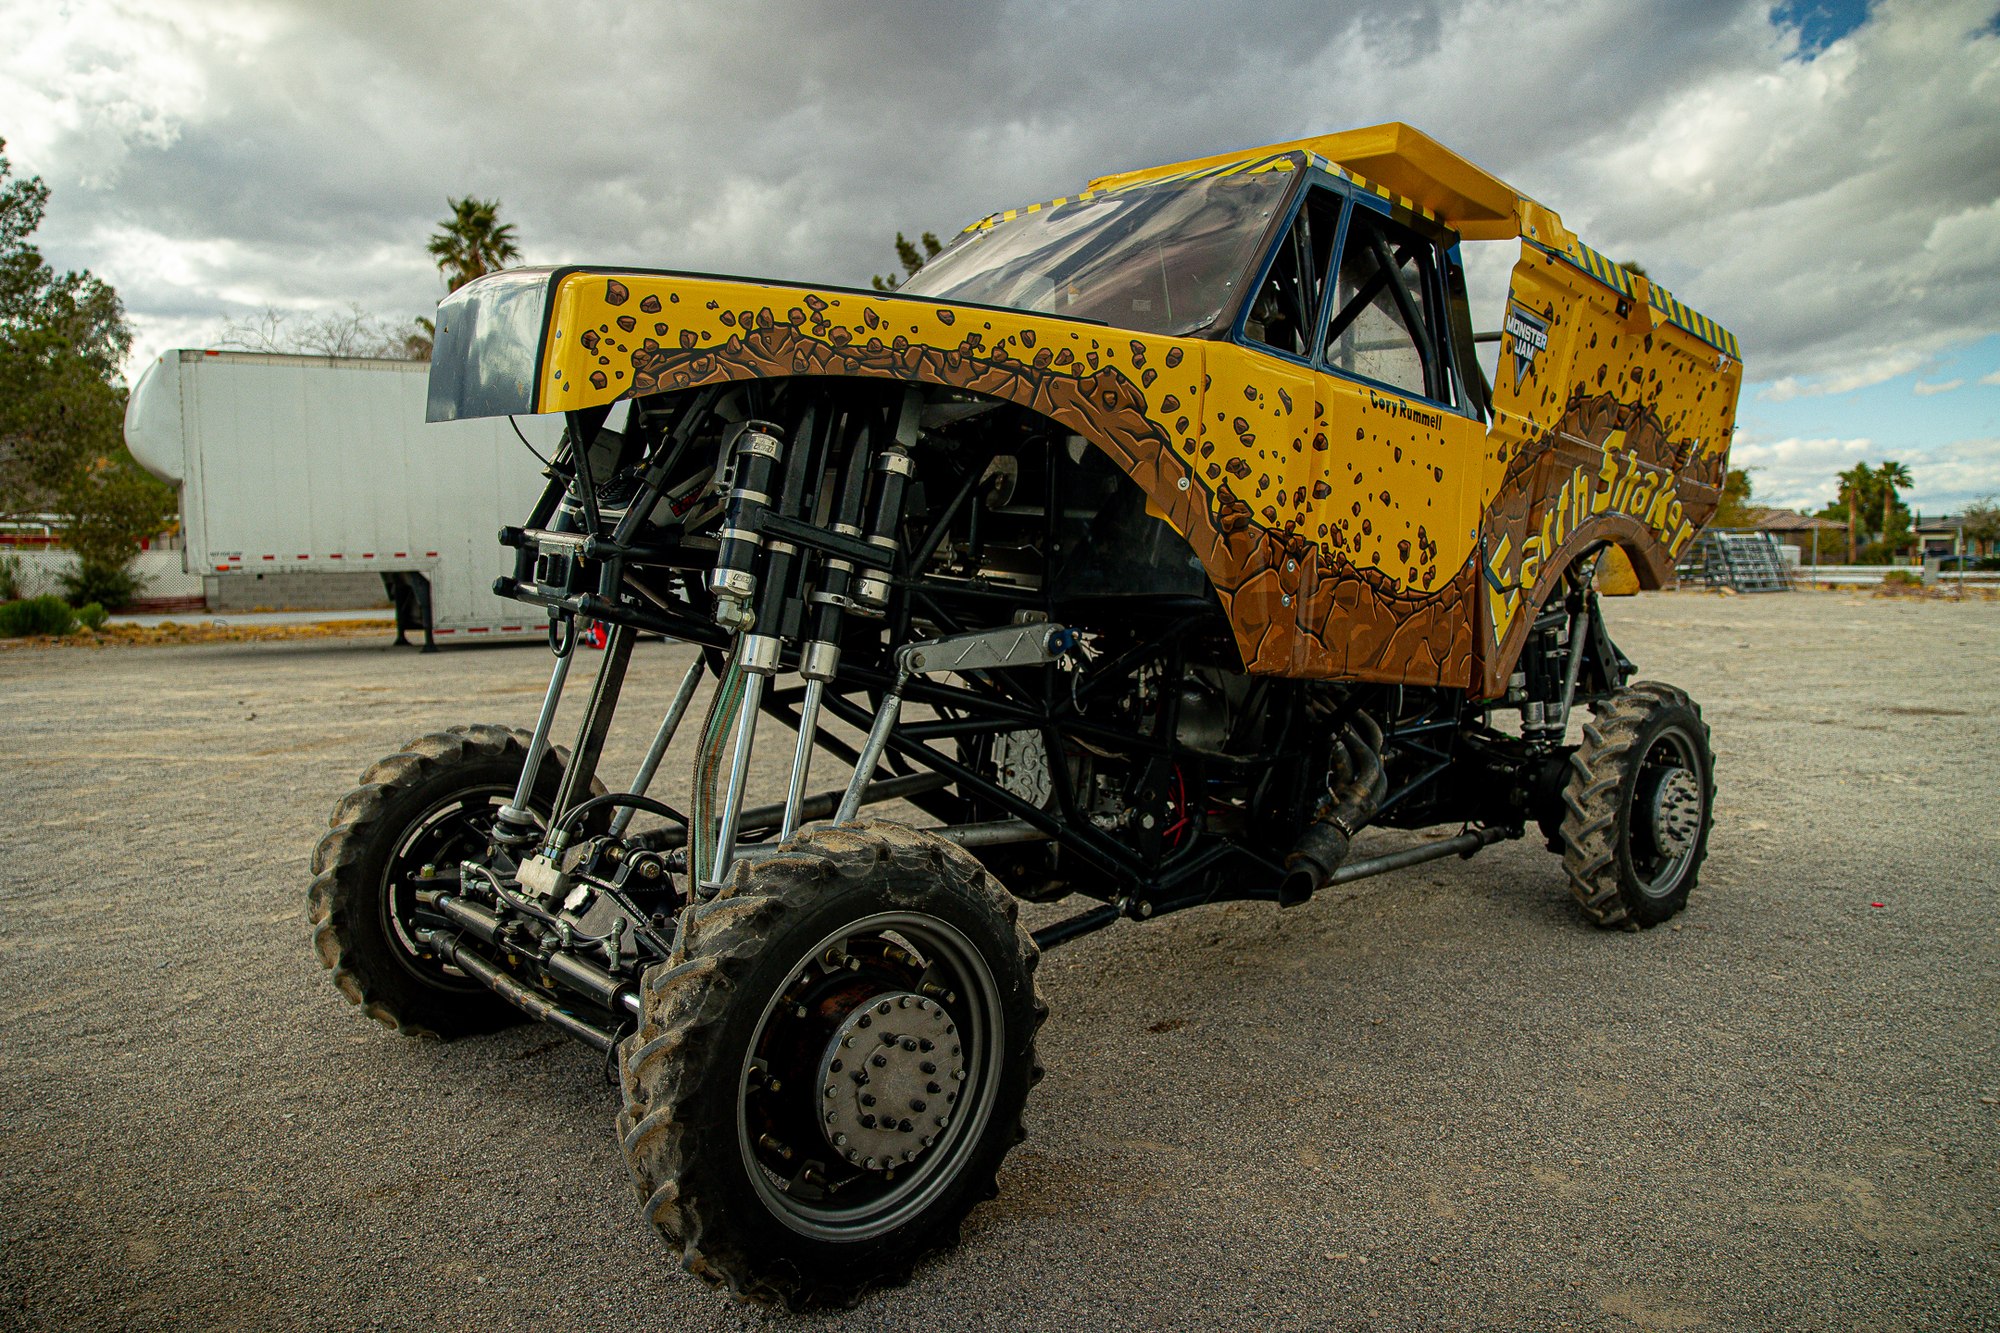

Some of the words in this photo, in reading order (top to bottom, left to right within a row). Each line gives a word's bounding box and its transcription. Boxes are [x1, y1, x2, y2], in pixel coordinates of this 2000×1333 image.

[1506, 315, 1548, 350] MONSTER
[1515, 340, 1535, 360] JAM
[1370, 390, 1397, 418] Cory
[1399, 399, 1442, 430] Rummell
